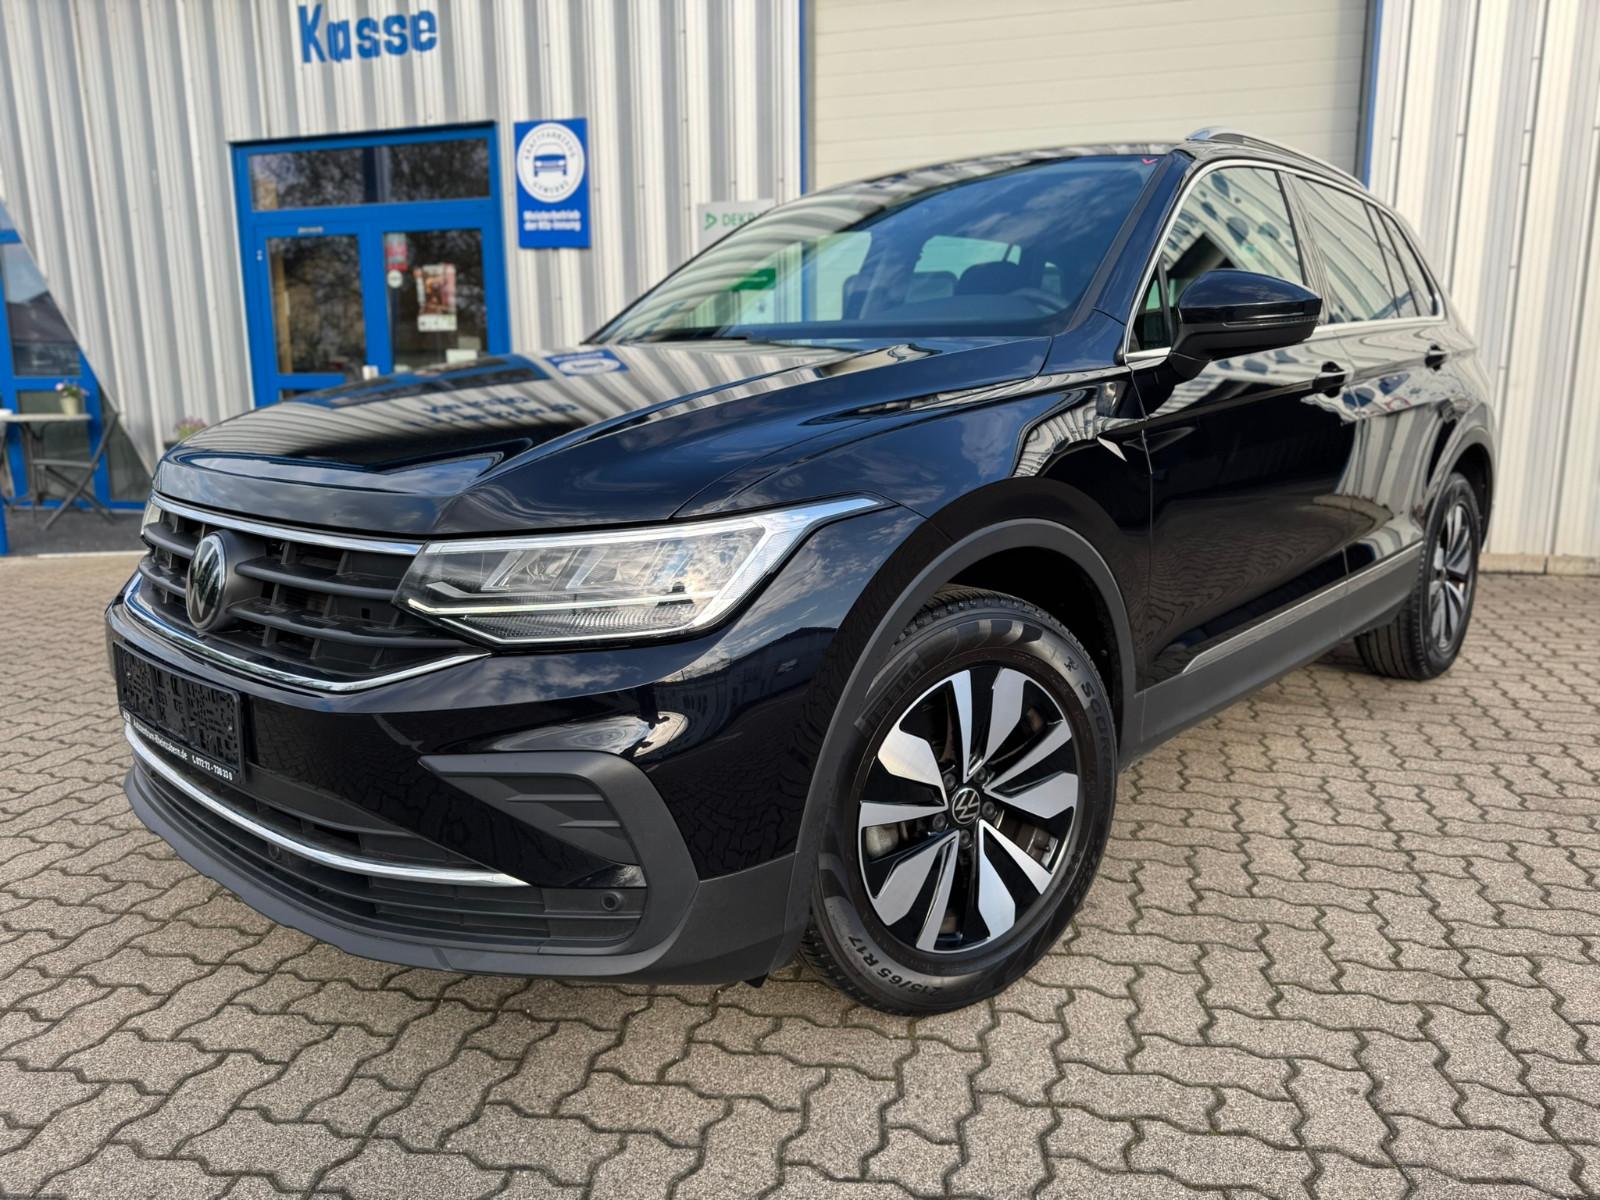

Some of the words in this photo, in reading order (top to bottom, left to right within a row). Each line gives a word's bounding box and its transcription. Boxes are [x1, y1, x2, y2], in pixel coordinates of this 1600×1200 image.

[298, 4, 437, 63] Kasse
[722, 211, 762, 228] DEKR
[848, 936, 879, 967] R17
[876, 968, 944, 997] 215/65
